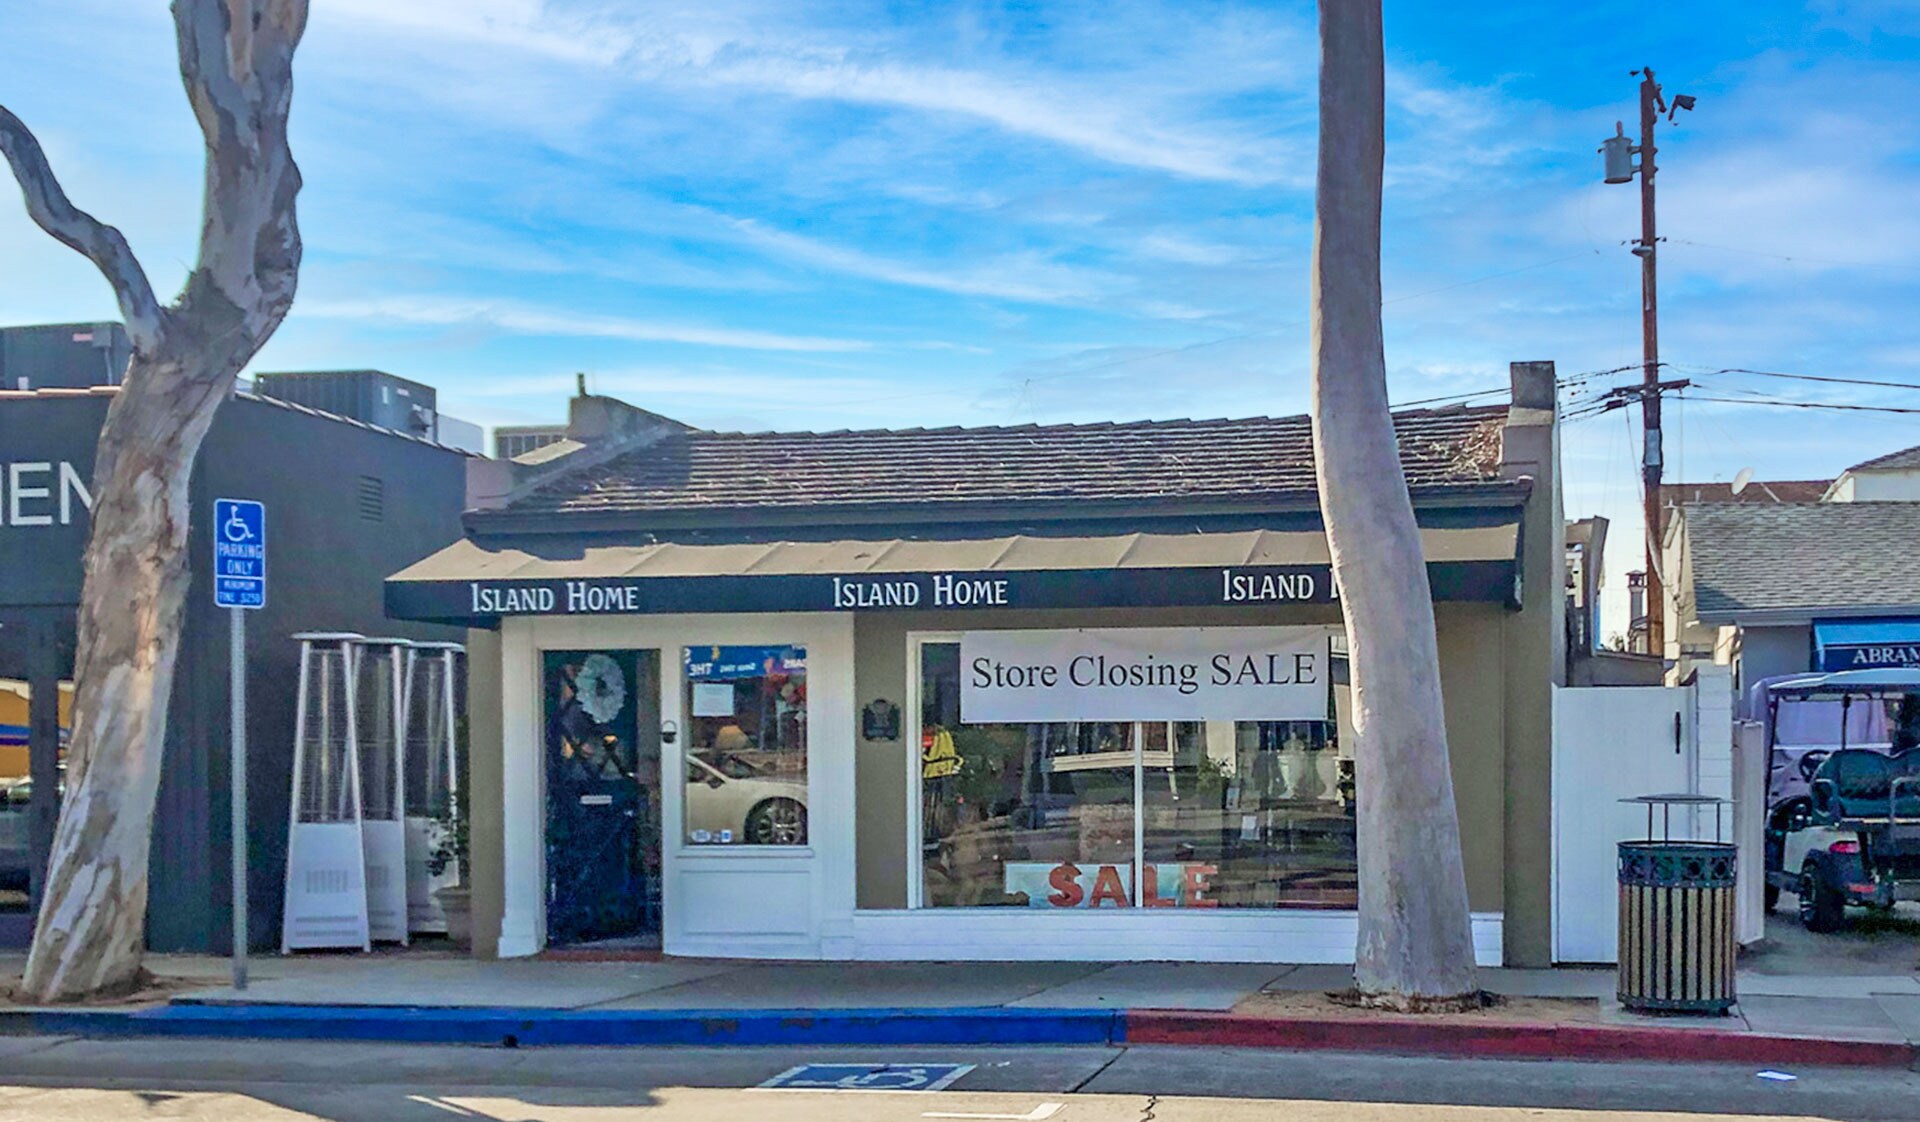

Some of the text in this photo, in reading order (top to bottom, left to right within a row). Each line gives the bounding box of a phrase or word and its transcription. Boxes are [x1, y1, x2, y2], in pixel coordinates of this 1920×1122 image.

[0, 461, 93, 525] EN
[218, 542, 262, 559] PARKING
[227, 559, 254, 575] ONLY
[470, 581, 639, 612] ISLAND HOME
[832, 574, 1008, 607] ISLAND HOME
[1222, 570, 1314, 601] ISLAND
[972, 654, 1317, 695] Store Closing SALE
[1048, 861, 1218, 908] SALE
